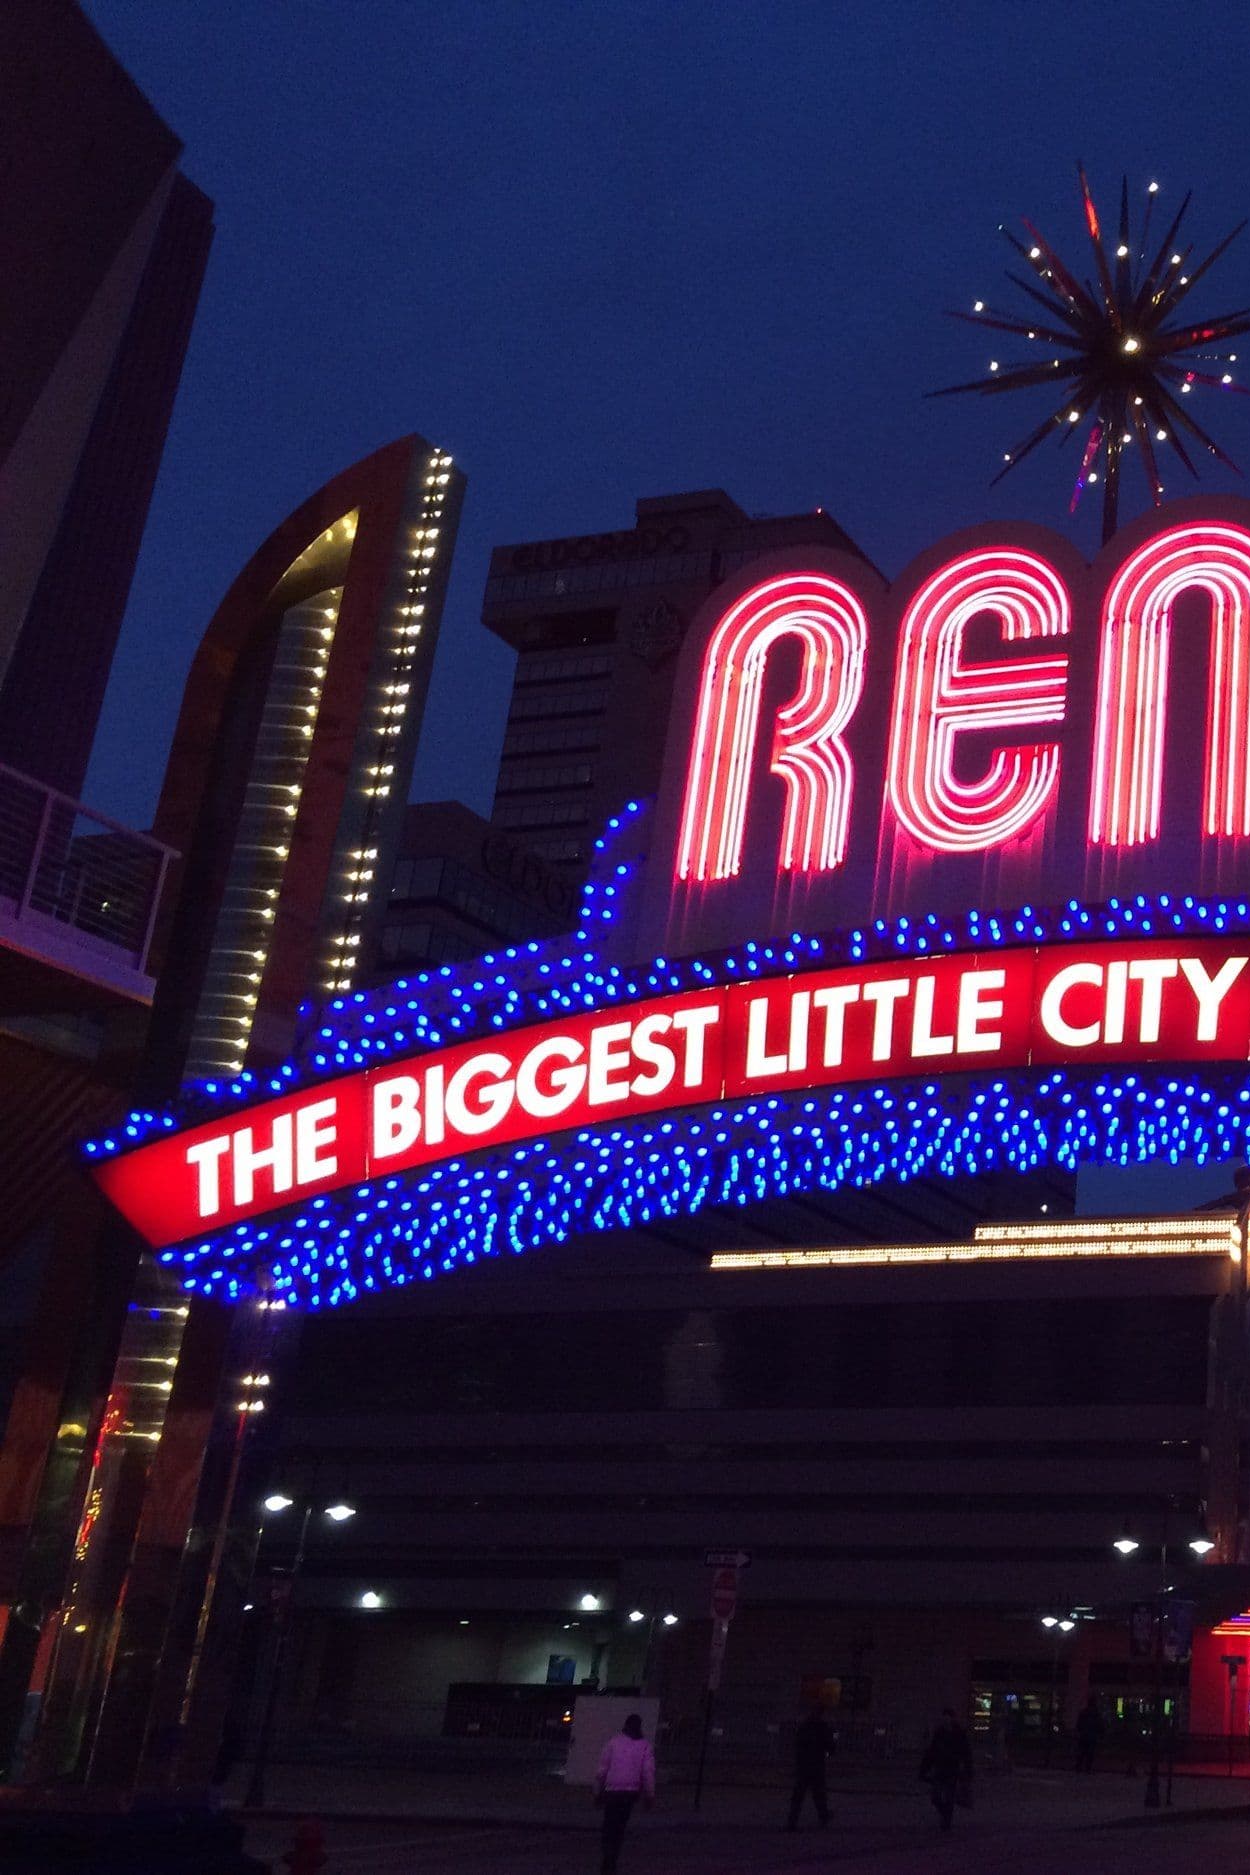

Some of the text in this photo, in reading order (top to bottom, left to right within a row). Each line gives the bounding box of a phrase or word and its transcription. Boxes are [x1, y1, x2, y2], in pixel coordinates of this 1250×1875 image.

[186, 1097, 338, 1217] THE
[372, 1005, 719, 1159] BIGGEST
[746, 969, 1006, 1078] LITTLE
[1040, 957, 1249, 1047] CITY
